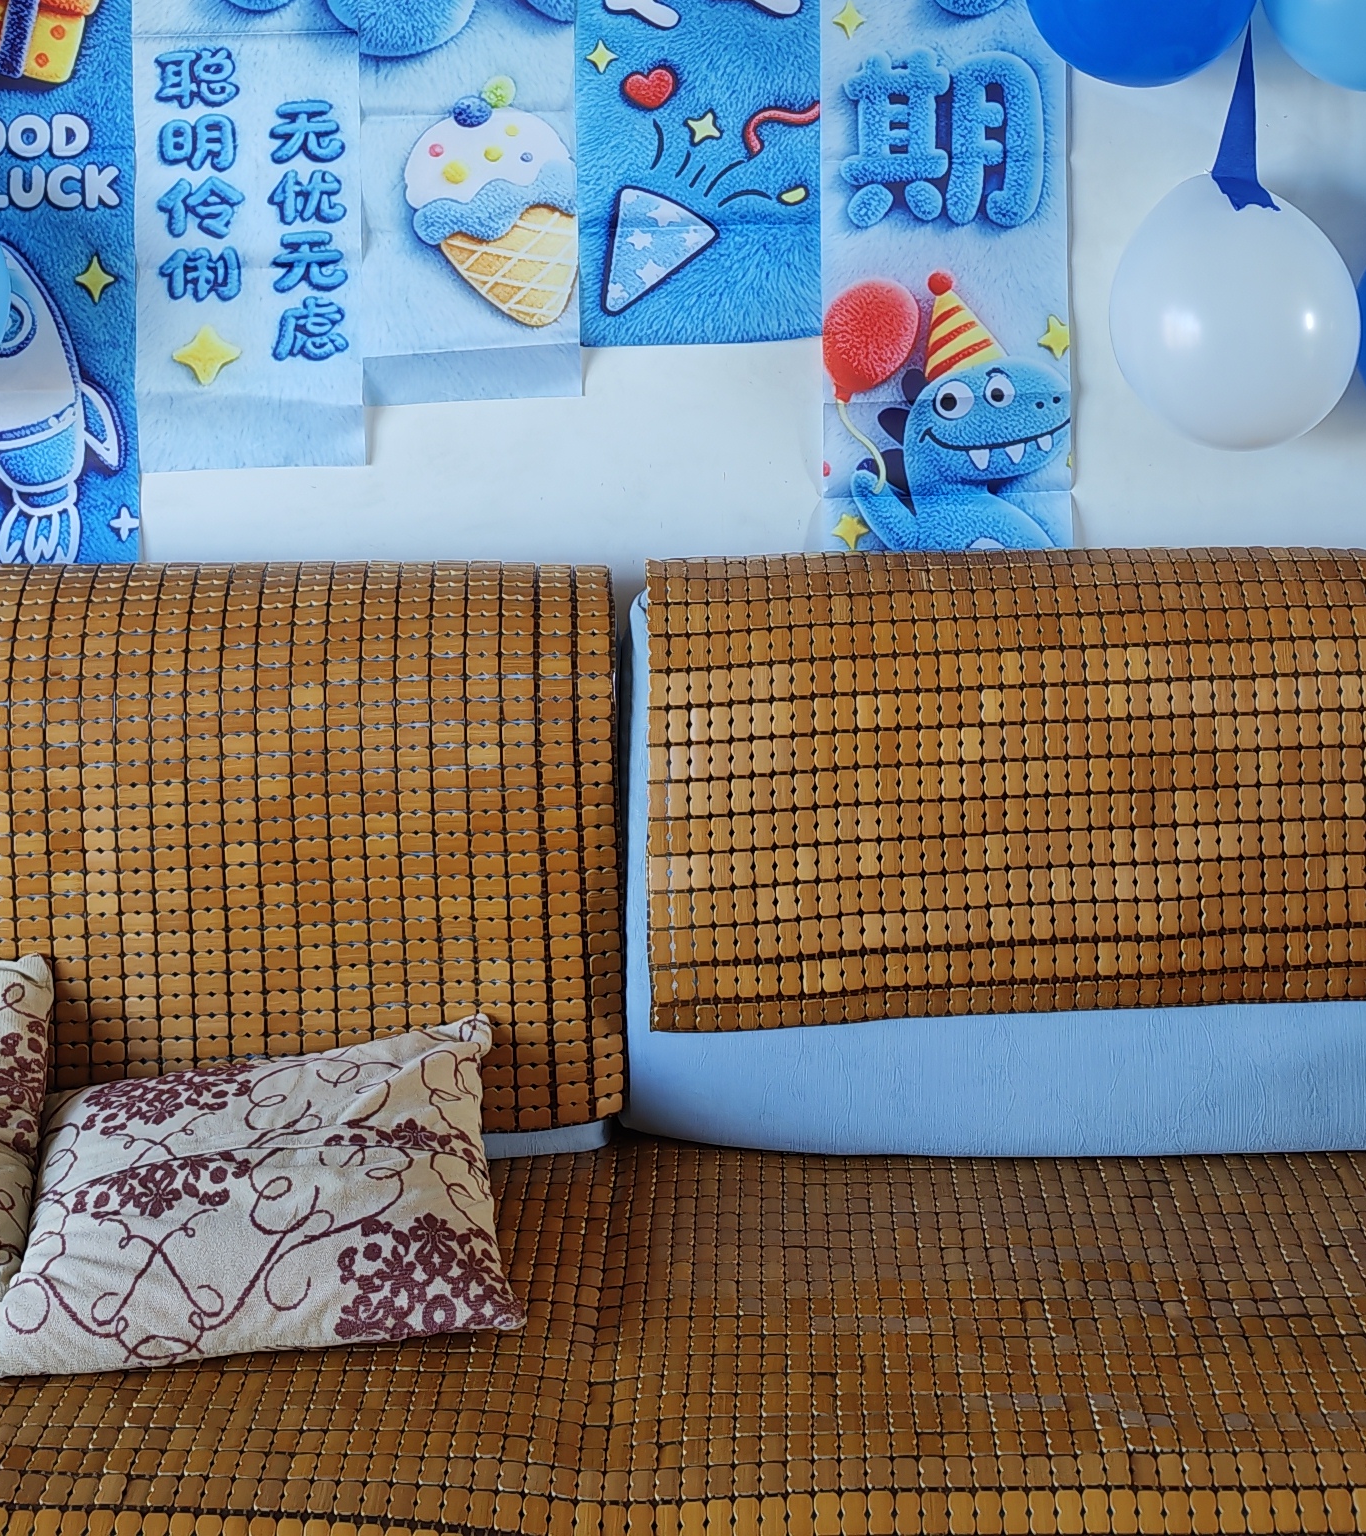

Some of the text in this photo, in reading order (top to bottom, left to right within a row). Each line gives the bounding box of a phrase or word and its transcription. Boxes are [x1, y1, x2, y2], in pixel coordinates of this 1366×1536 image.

[154, 47, 241, 302] 聪明伶俐
[267, 99, 349, 361] 无忧无虑
